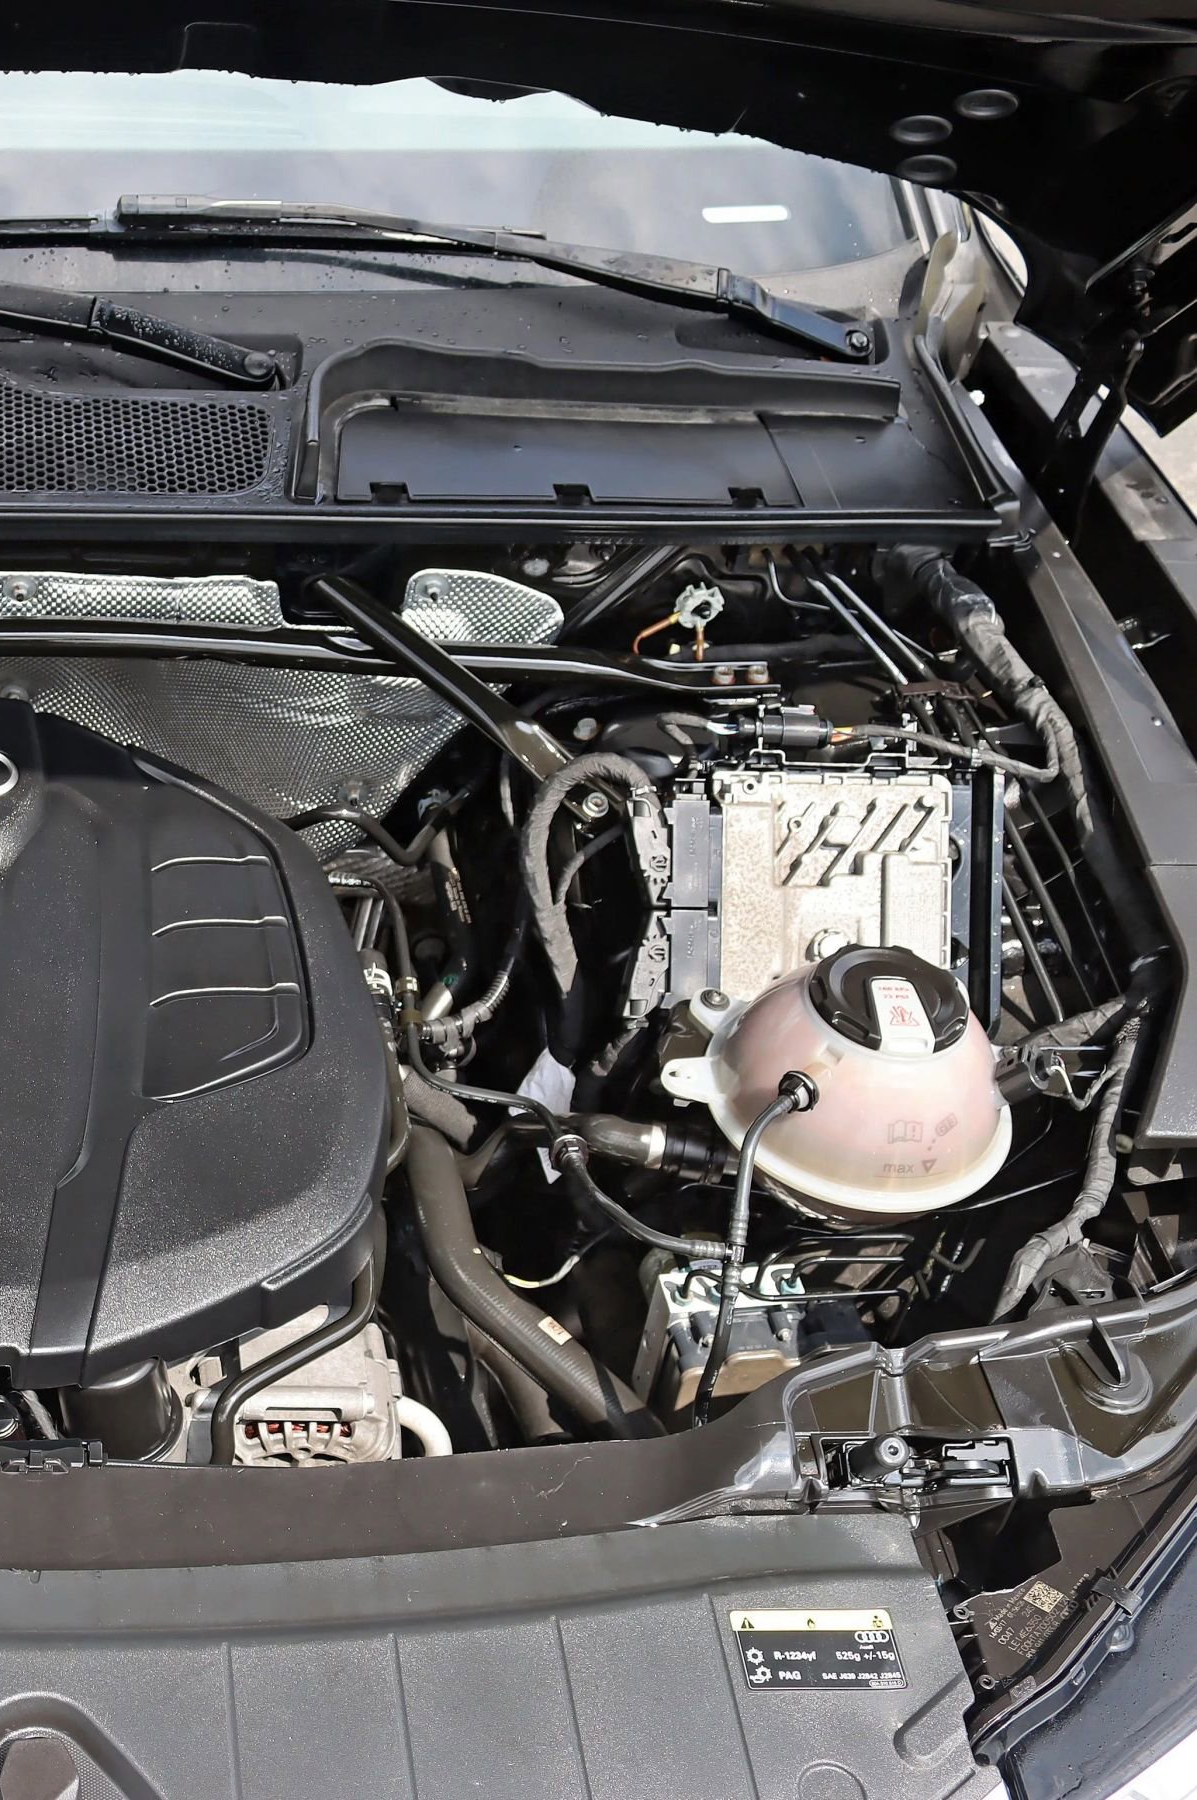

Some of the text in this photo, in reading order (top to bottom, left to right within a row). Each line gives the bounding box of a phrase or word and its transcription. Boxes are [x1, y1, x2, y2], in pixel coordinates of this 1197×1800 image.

[883, 1163, 915, 1174] max
[997, 1626, 1016, 1645] 0047
[773, 1650, 896, 1662] R-1234yf 525g +/-15g
[779, 1671, 802, 1680] PAG
